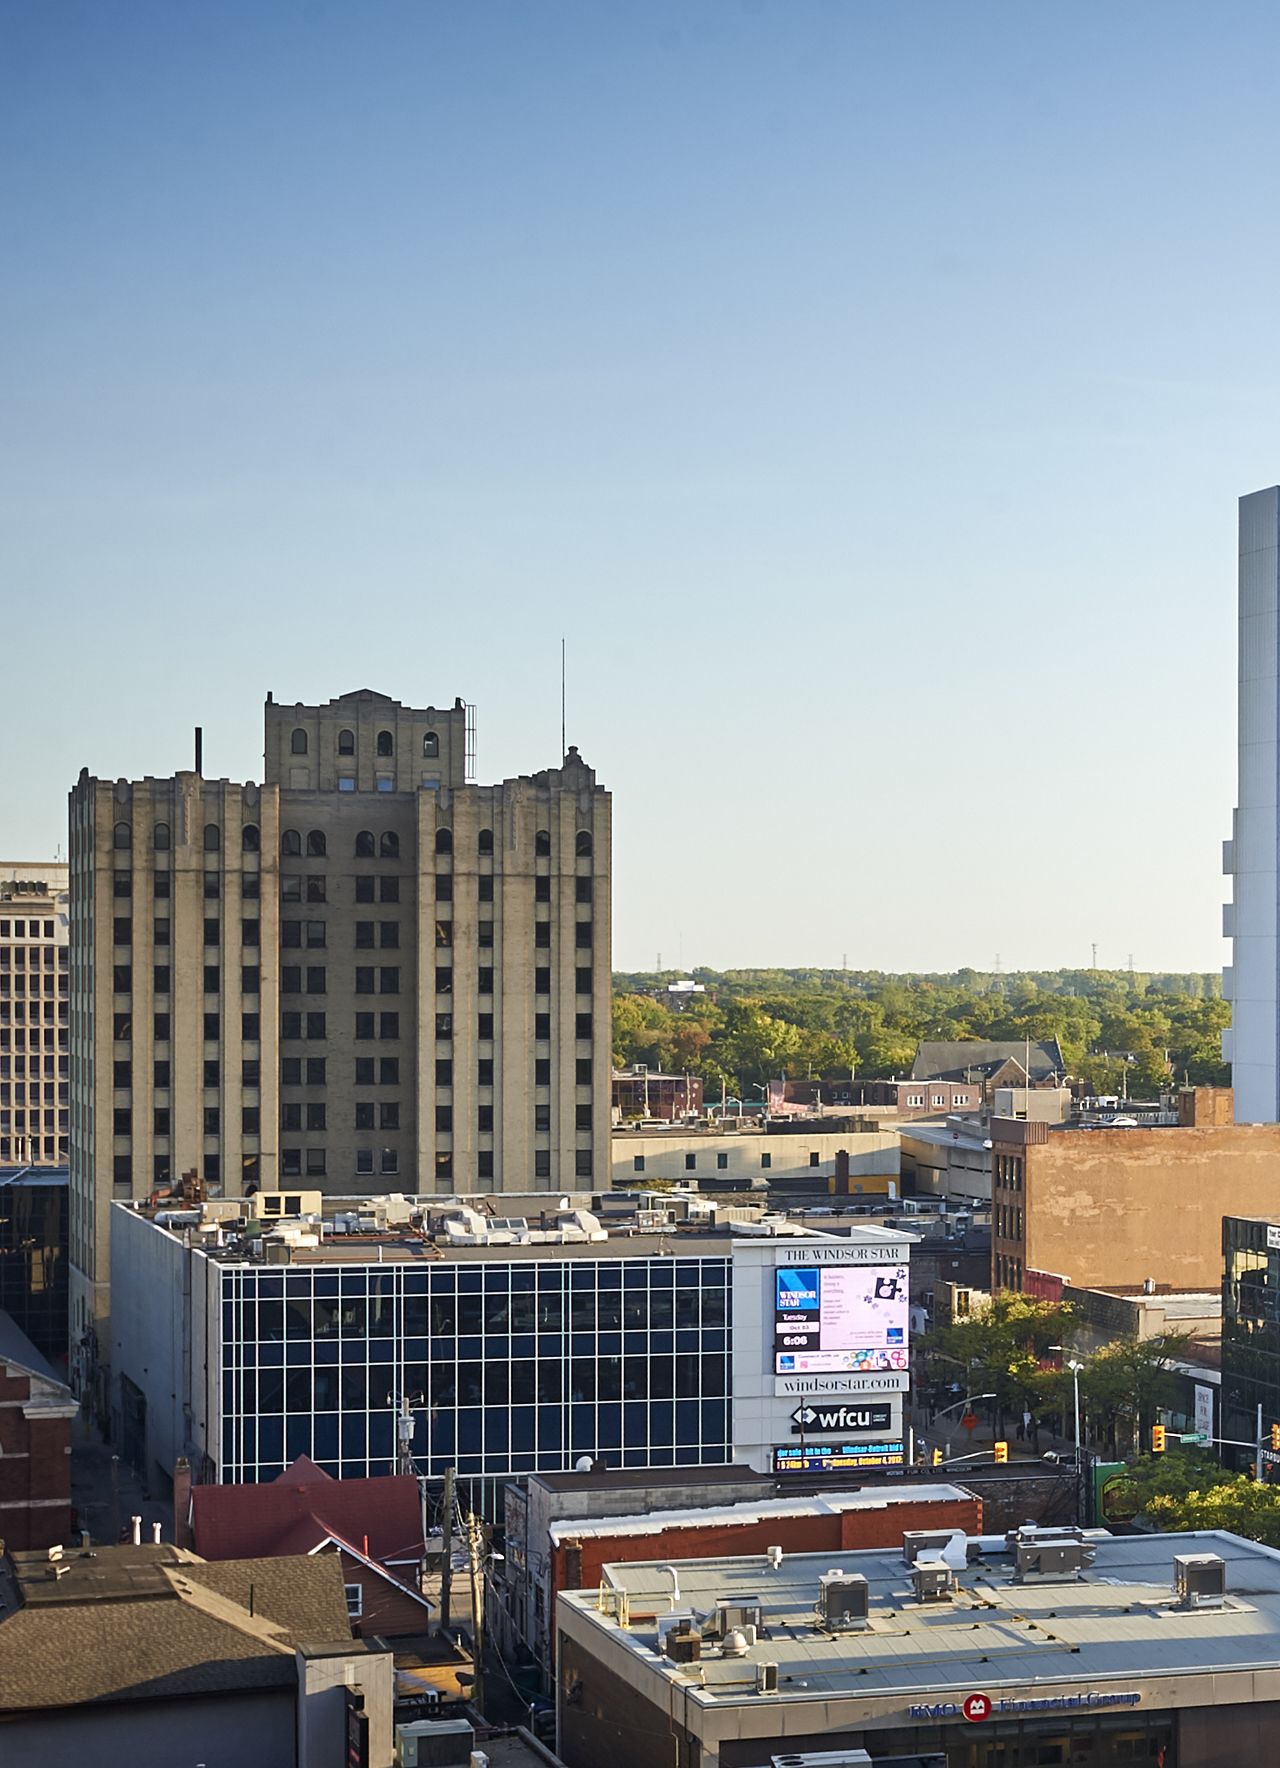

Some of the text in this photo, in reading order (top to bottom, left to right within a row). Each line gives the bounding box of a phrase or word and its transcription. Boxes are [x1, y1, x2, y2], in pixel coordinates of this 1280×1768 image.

[785, 1248, 899, 1261] THE WINDSOR STAR
[779, 1290, 816, 1299] WINDSOR
[779, 1299, 800, 1307] STAR
[782, 1313, 808, 1322] Tuesday
[784, 1378, 900, 1392] windsorstar.com
[819, 1408, 870, 1427] wfcu
[909, 1690, 1142, 1719] BMO Financial Group
